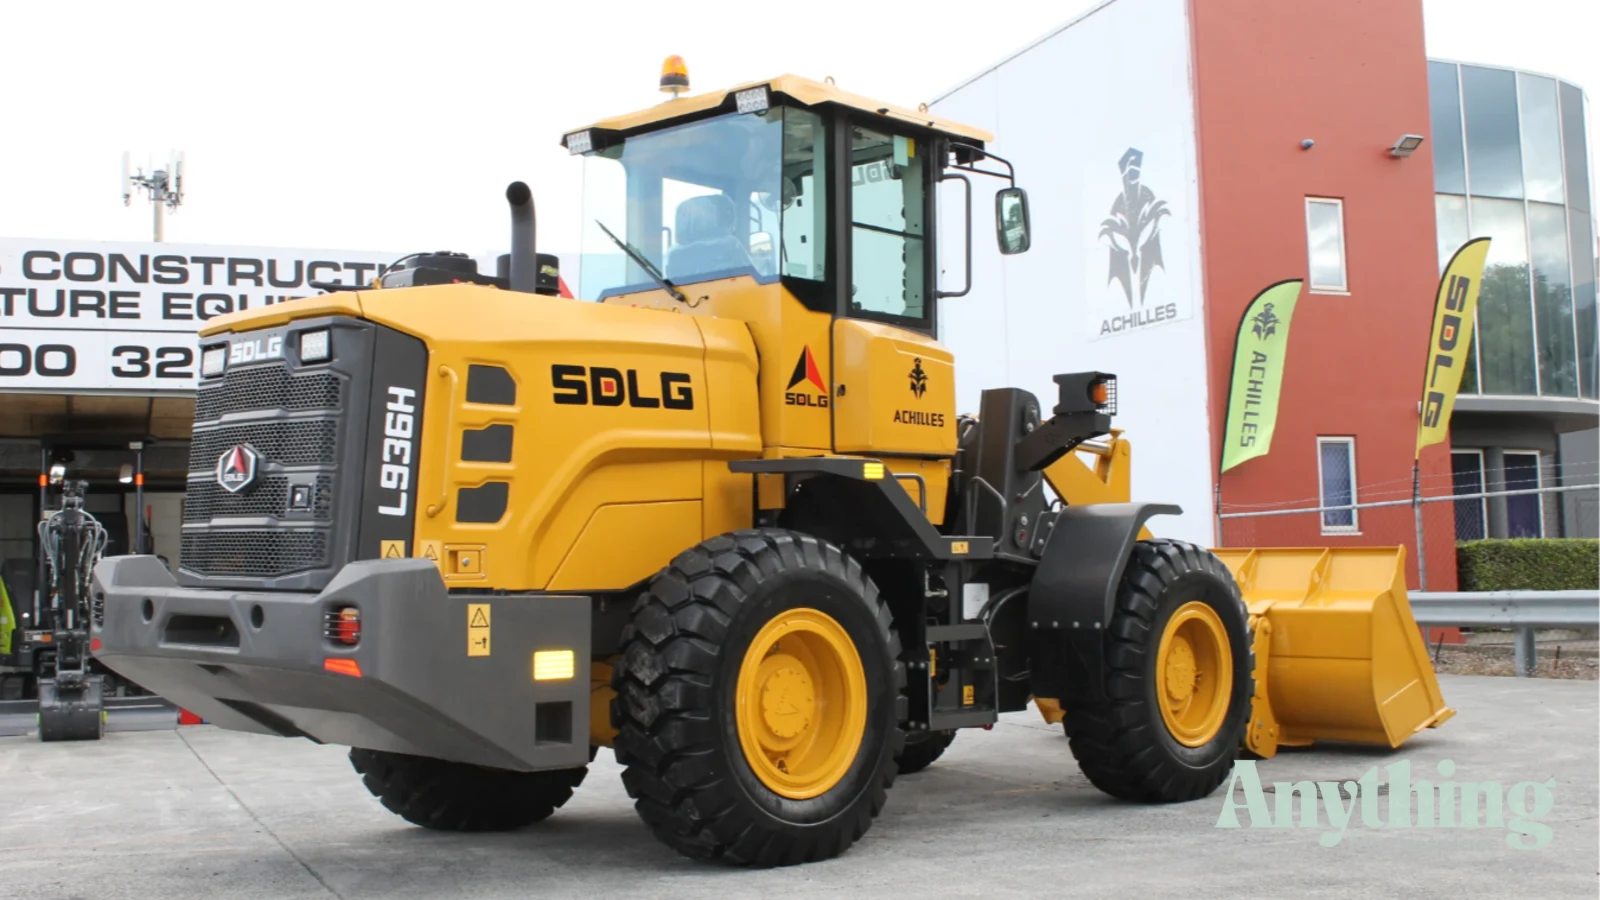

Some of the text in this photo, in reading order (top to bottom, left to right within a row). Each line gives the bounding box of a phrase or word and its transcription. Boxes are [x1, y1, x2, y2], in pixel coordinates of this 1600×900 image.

[22, 250, 405, 289] CONSTRUCT
[1100, 303, 1177, 335] ACHILLES
[111, 345, 194, 379] 32
[230, 336, 282, 363] SDLG
[1423, 274, 1470, 428] SDLG
[551, 364, 694, 410] SDLG
[785, 392, 829, 408] SDLG
[1240, 351, 1267, 448] ACHILLES
[893, 409, 944, 428] ACHILLES
[378, 386, 416, 516] L936H
